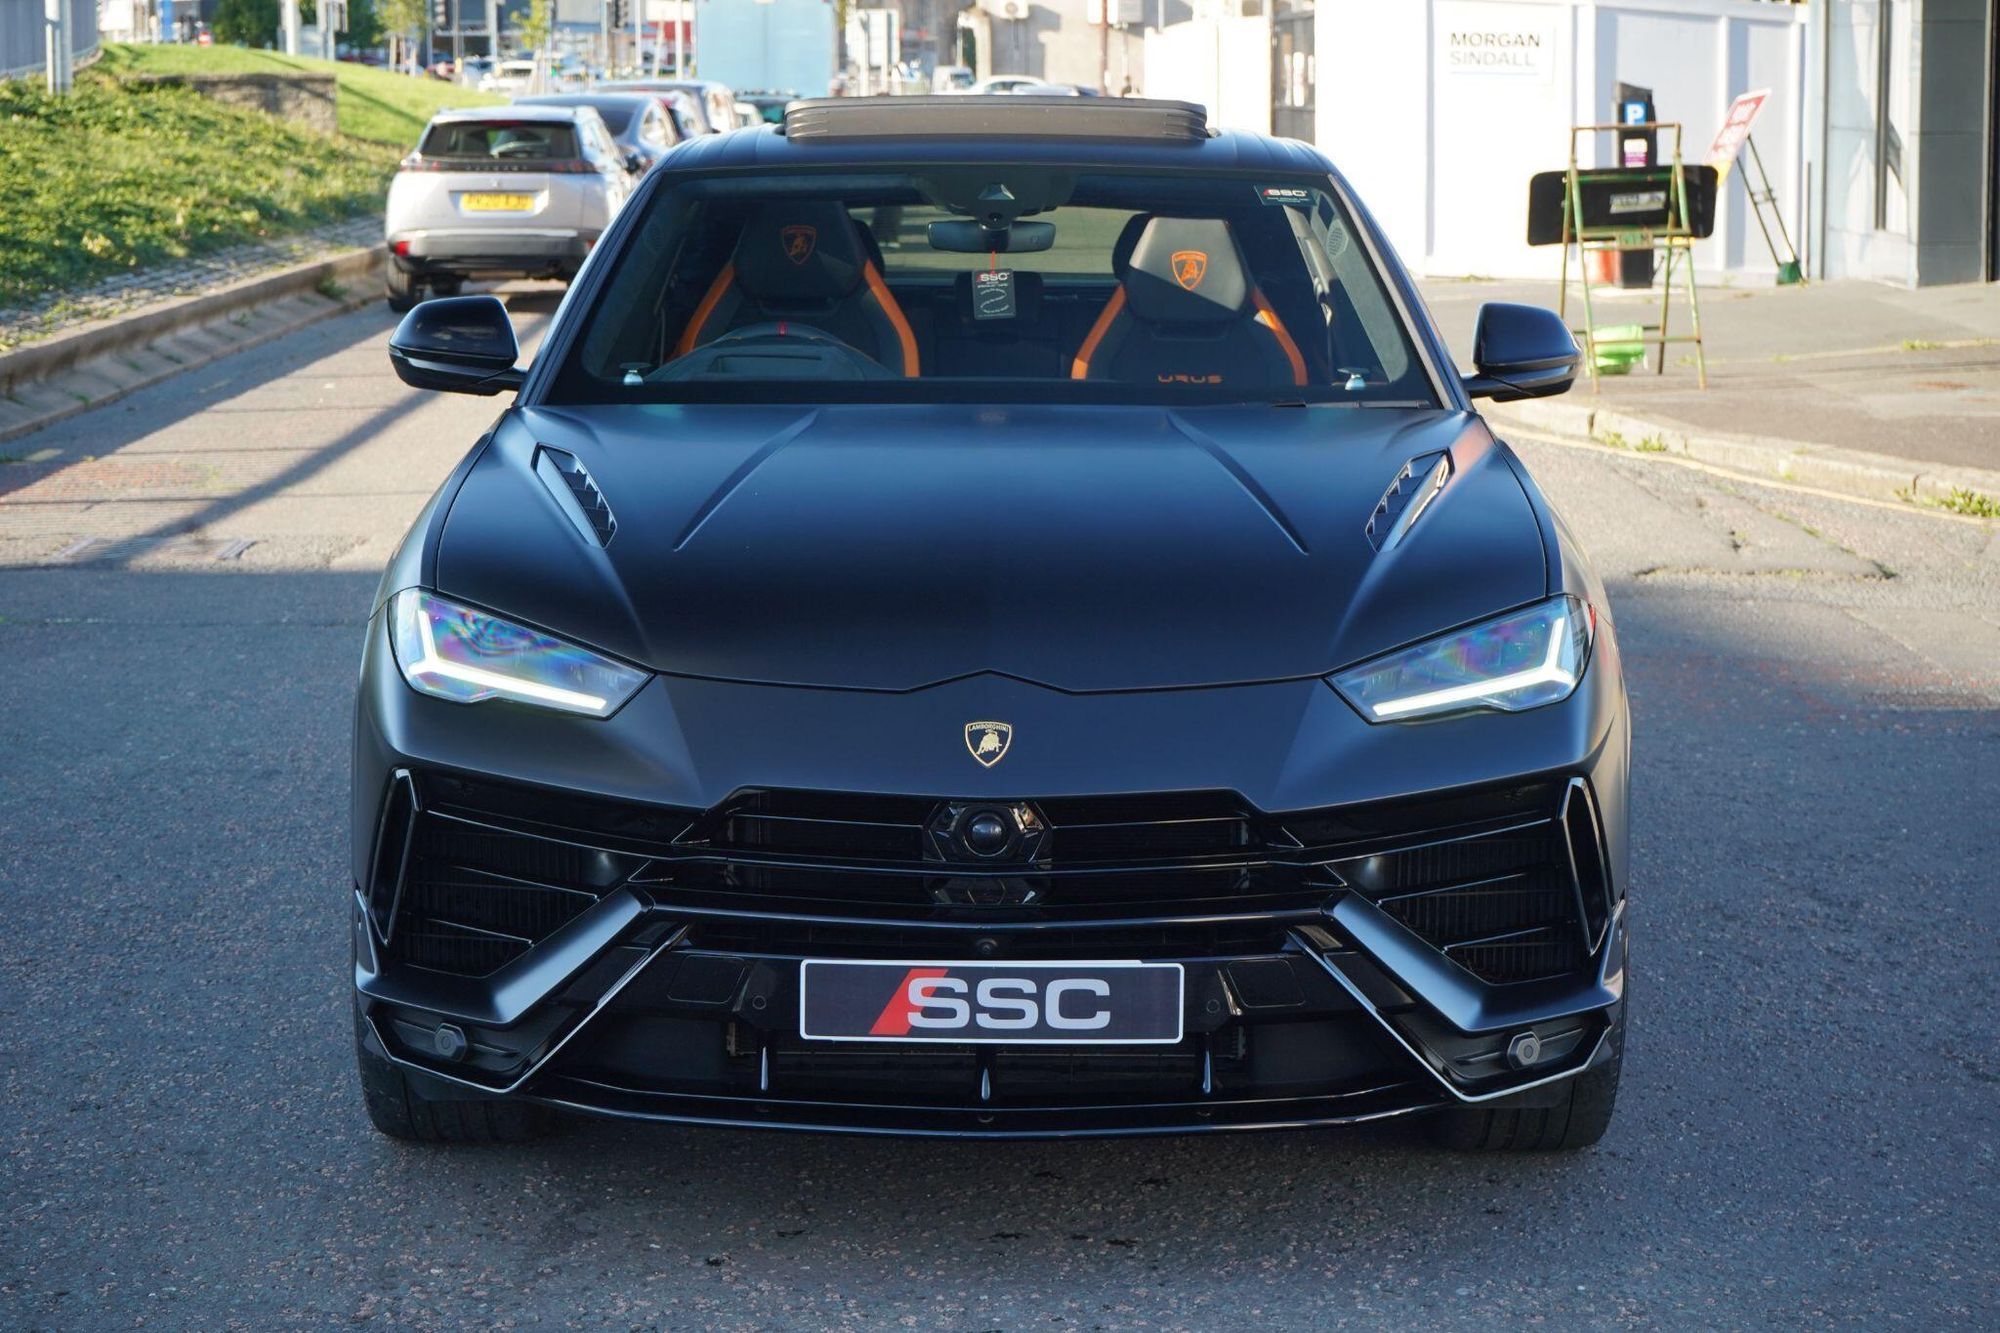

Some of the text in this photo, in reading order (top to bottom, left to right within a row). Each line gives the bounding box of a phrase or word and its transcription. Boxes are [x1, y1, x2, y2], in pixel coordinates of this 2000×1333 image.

[1450, 32, 1540, 47] MORGAN
[1450, 50, 1535, 67] SINDALL
[1626, 104, 1645, 125] P
[1157, 374, 1222, 384] URUS
[907, 977, 1112, 1030] SSC
